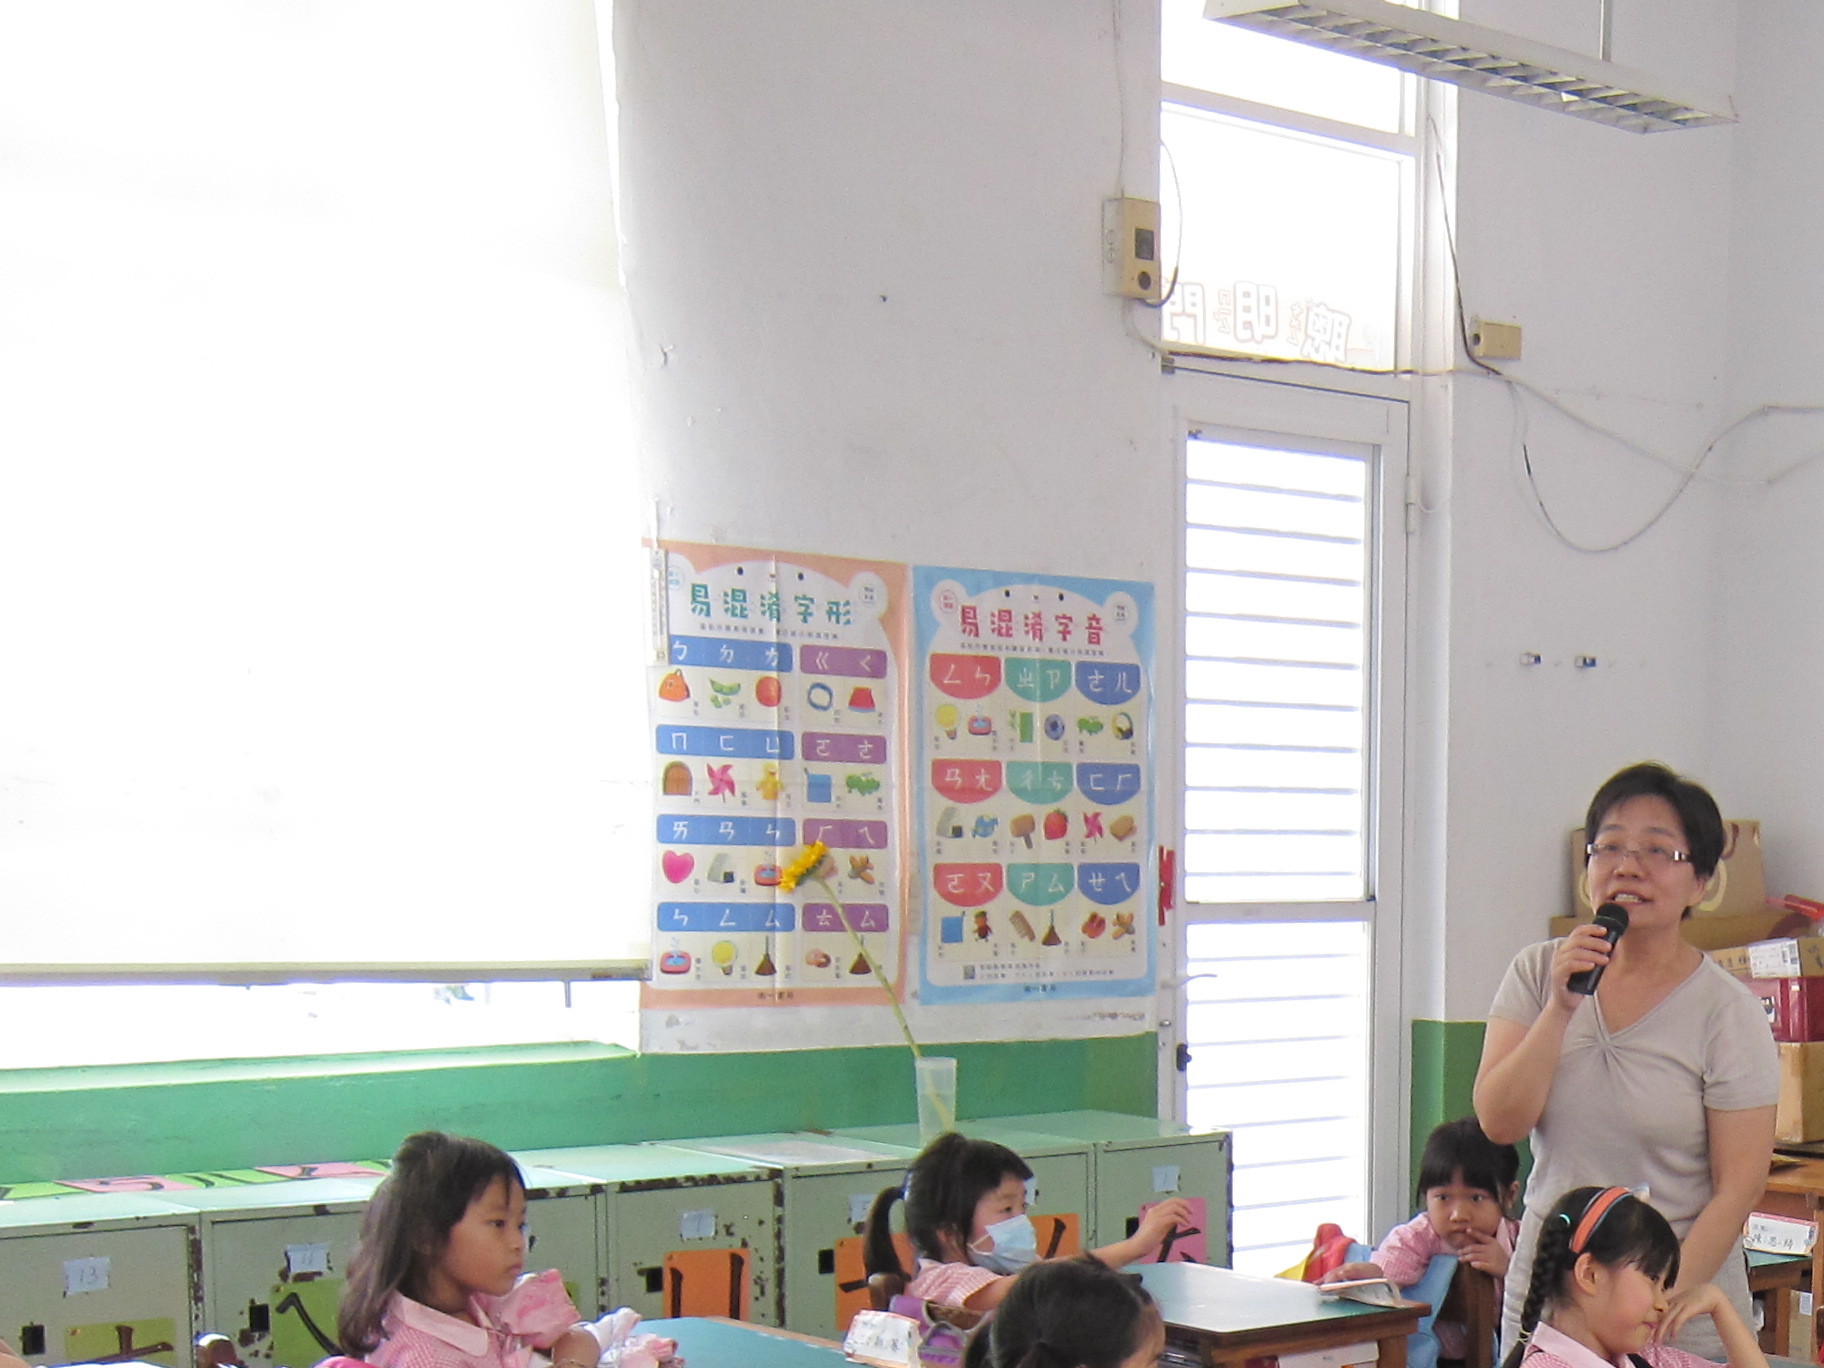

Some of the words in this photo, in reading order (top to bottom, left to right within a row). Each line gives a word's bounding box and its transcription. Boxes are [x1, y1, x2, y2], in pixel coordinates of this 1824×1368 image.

[690, 583, 853, 625] 易混淆字形
[961, 604, 1104, 645] 易混淆字音
[80, 1268, 98, 1284] 13
